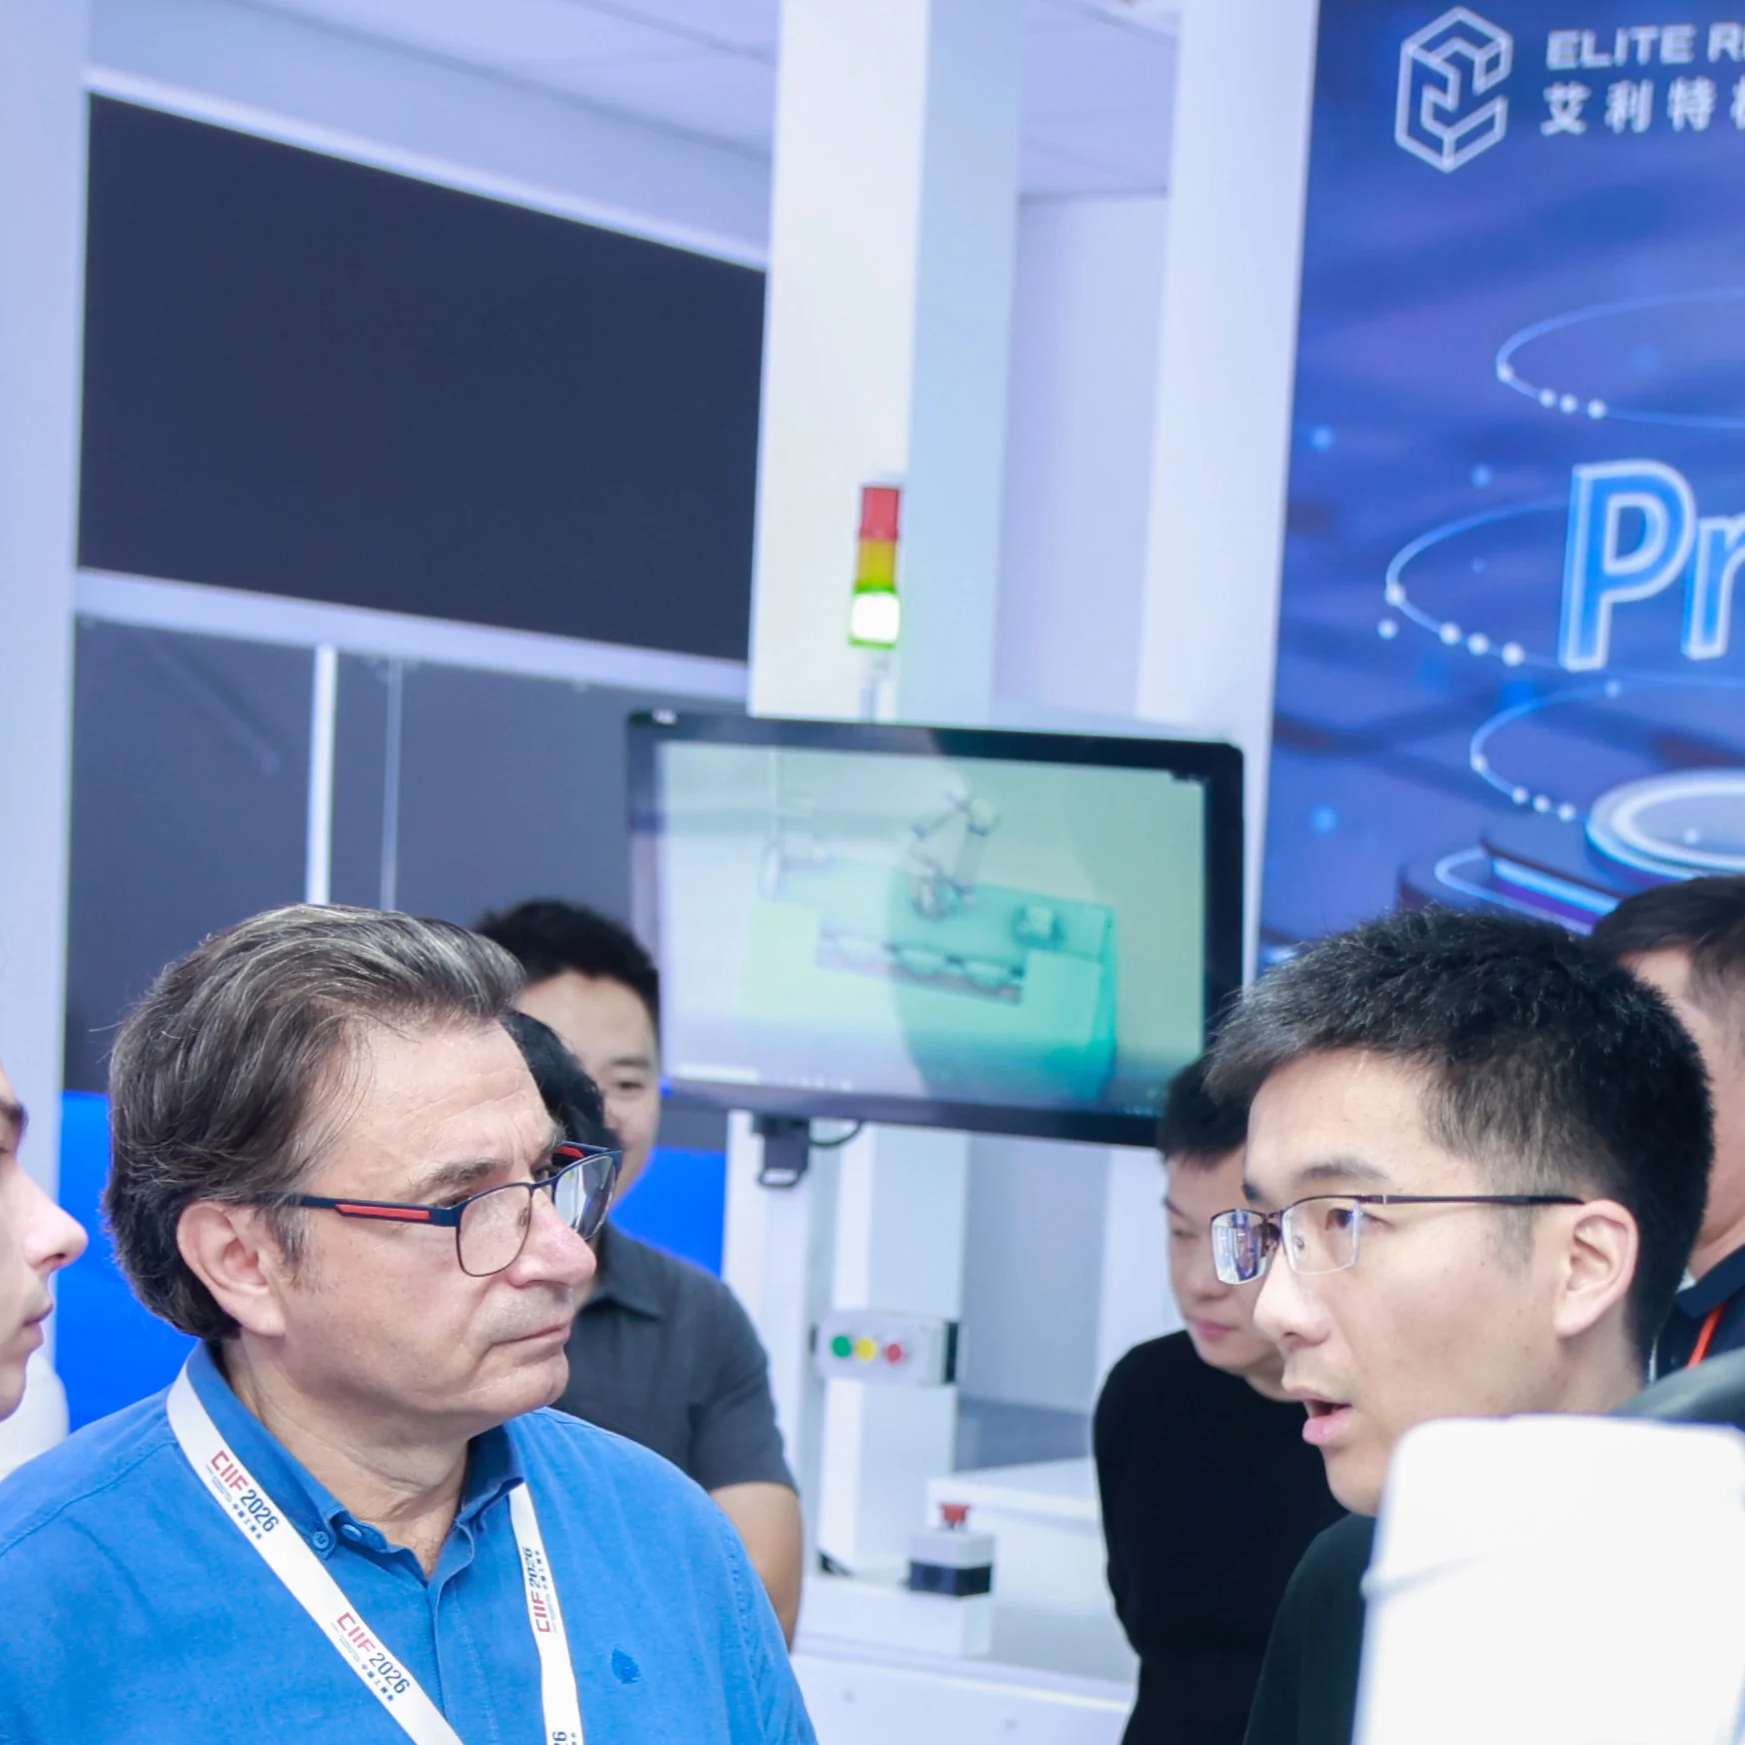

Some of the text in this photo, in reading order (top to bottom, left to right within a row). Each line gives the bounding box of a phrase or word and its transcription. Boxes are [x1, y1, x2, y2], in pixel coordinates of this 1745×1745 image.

[1546, 26, 1693, 69] ELITE
[211, 1450, 249, 1491] CIIF
[240, 1489, 279, 1532] 2026
[531, 1590, 551, 1632] CIIF
[337, 1612, 376, 1652] CIIF
[369, 1652, 410, 1693] 2026
